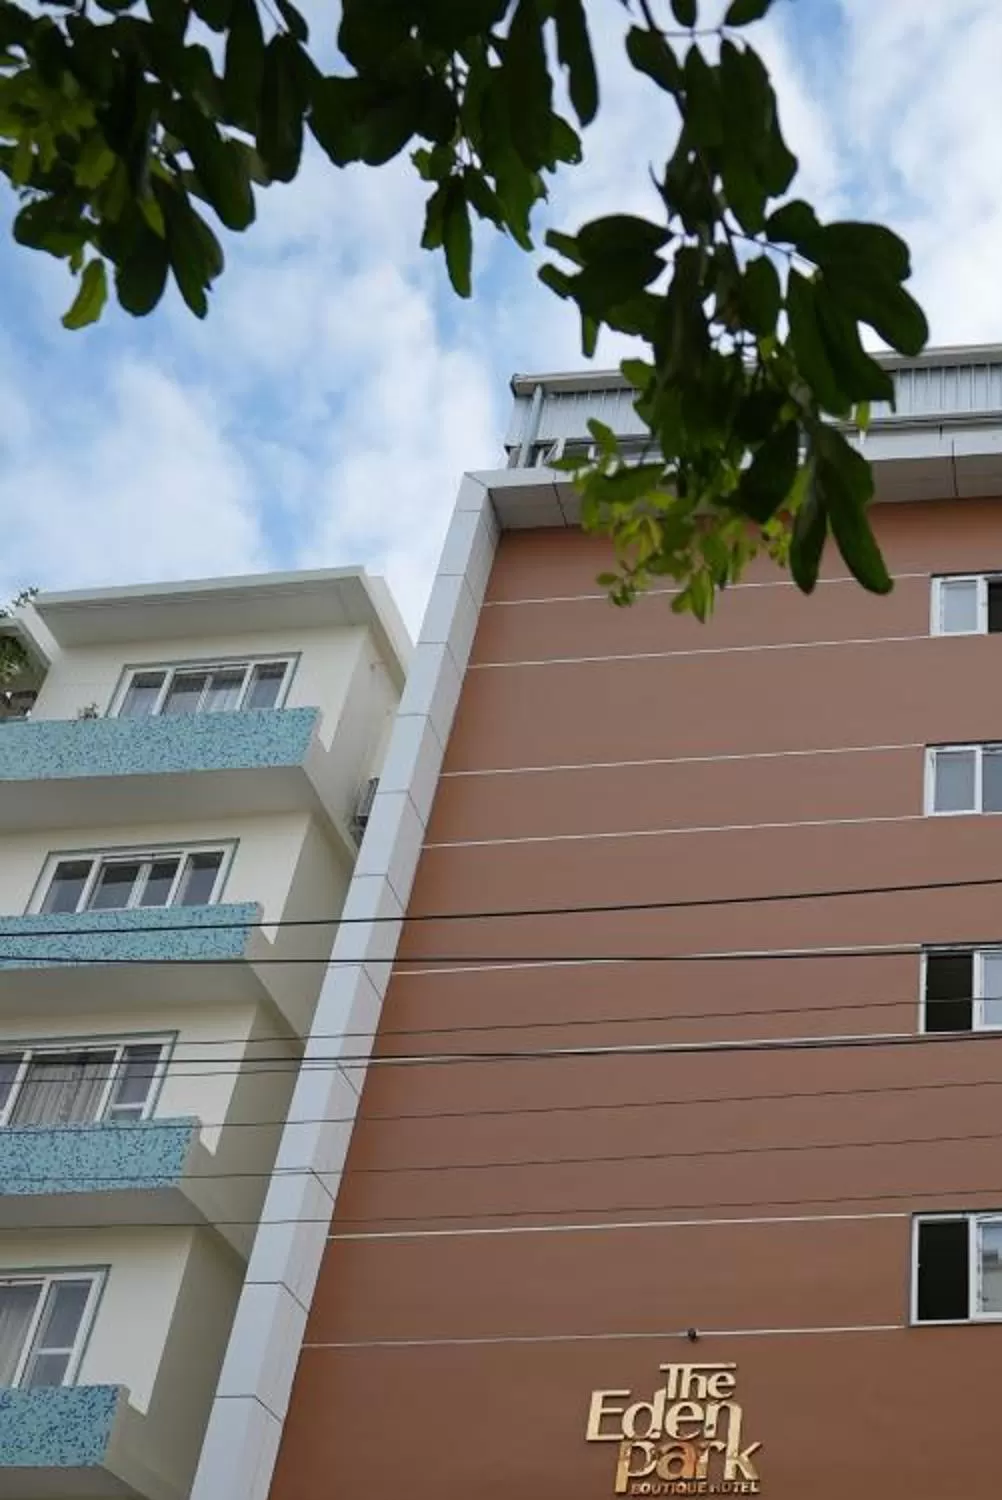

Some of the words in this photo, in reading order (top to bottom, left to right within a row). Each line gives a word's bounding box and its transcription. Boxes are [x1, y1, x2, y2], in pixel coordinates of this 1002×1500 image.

[659, 1362, 737, 1400] The
[586, 1388, 743, 1441] Eden
[631, 1482, 707, 1495] BOUTIQUE
[709, 1481, 761, 1493] HOTEL
